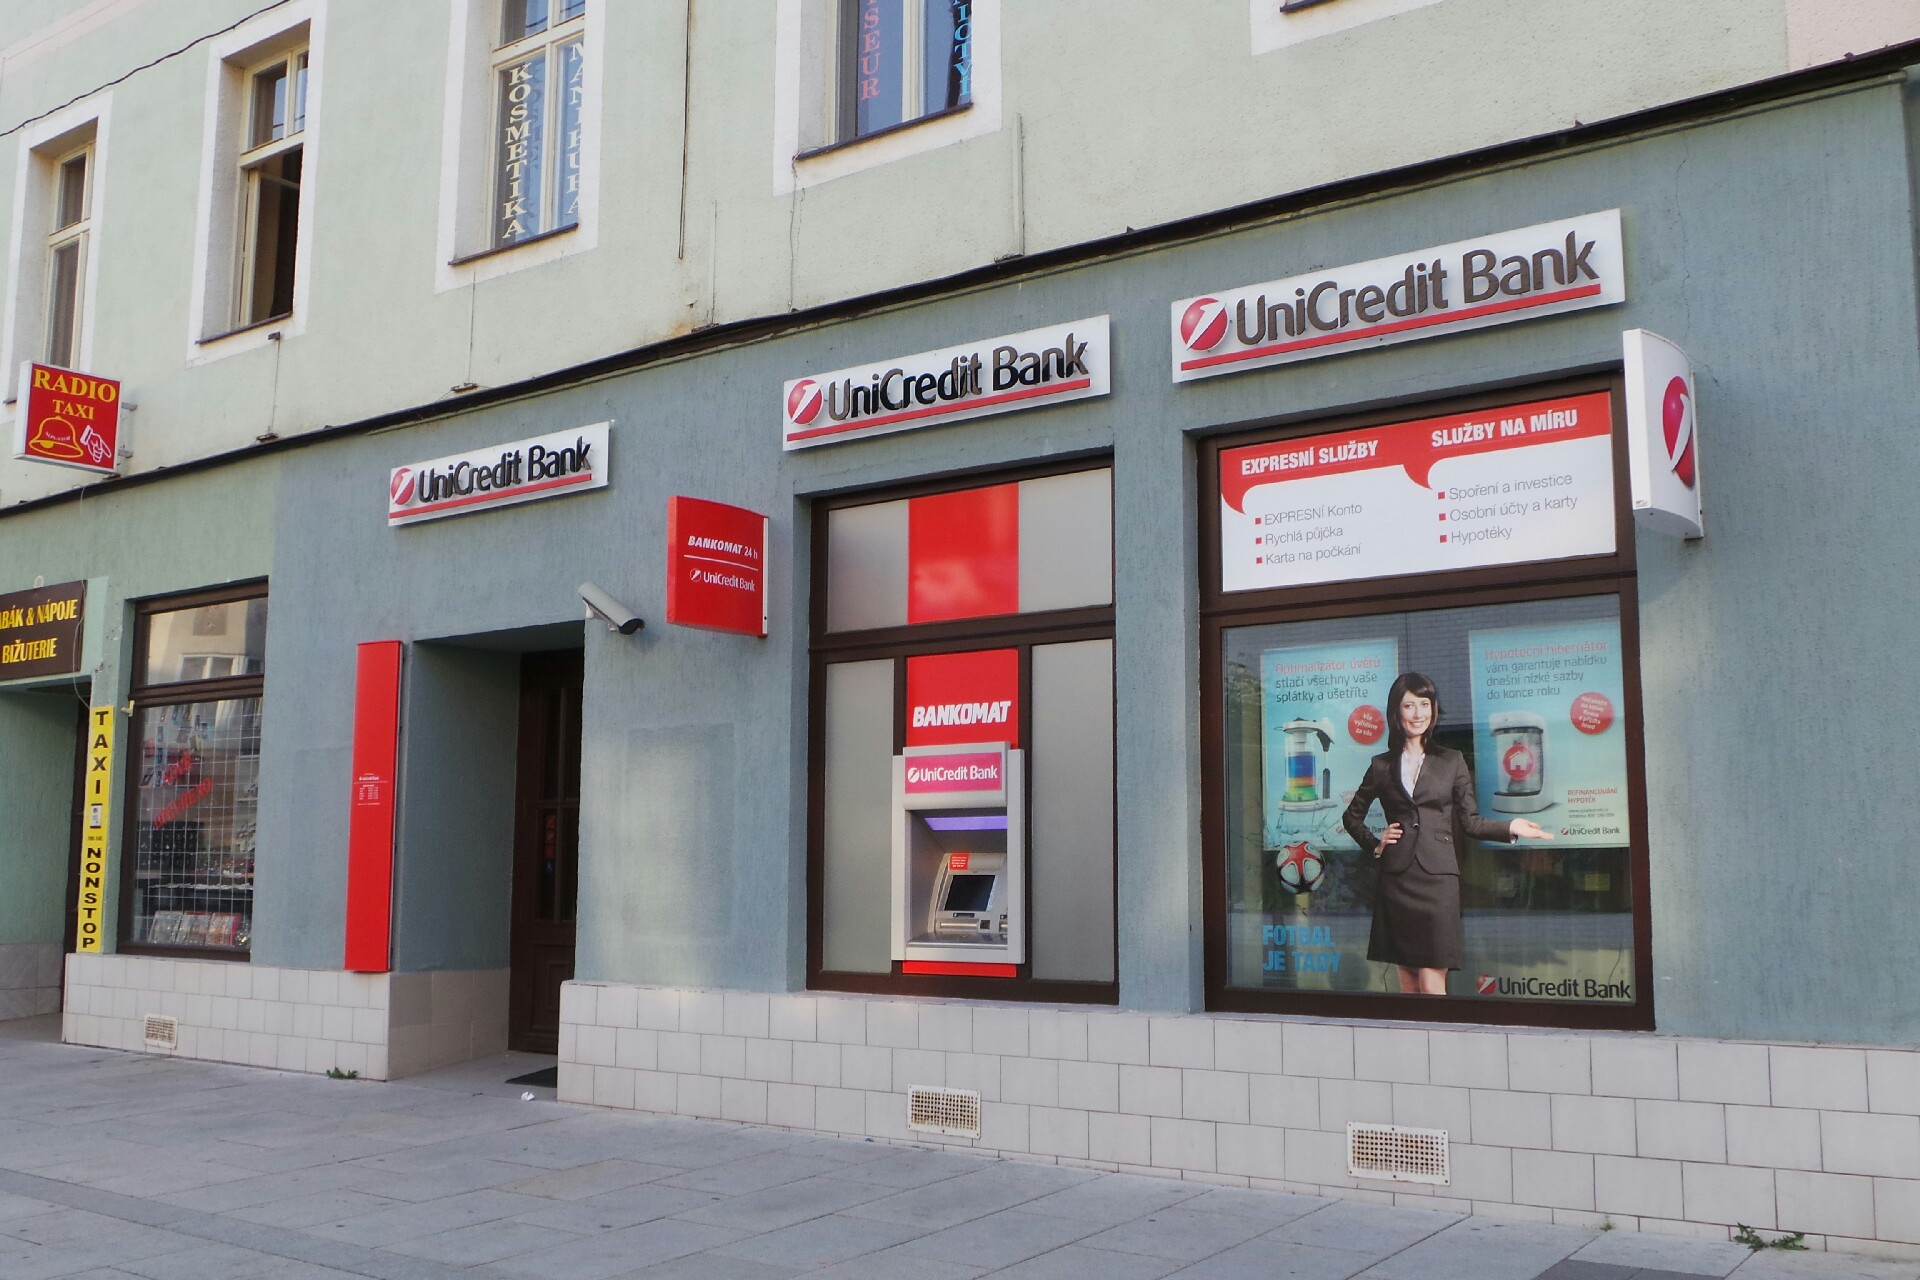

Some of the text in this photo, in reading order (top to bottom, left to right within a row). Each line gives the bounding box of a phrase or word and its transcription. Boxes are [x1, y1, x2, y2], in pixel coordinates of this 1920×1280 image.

[861, 0, 880, 100] SEUR
[503, 62, 533, 238] KOSMETIKA
[1236, 230, 1599, 345] UniCredit Bank
[33, 368, 116, 402] RADIO
[828, 332, 1089, 421] UniCredit Bank
[53, 399, 94, 420] TAXI
[1431, 409, 1578, 447] SLUŽBY NA MÍRU
[418, 435, 592, 503] UniCredit Bank
[1241, 439, 1378, 476] EXPRESNÍ SLUŽBY
[1449, 474, 1573, 501] Spoření a investice
[1264, 503, 1362, 526] EXPRESNÍ Konto
[1450, 495, 1578, 521] Osobní účty a karty
[688, 535, 758, 559] BANKOMAT 24 h
[1265, 526, 1344, 547] Rychlá půjčka
[1451, 526, 1513, 545] Hypotéky
[1265, 542, 1361, 565] Karta na počkání
[703, 571, 755, 592] UniCredit Bank
[0, 599, 78, 630] BÁK & NÁPOJE
[2, 638, 58, 664] BIŽUTERIE
[1485, 655, 1607, 674] vám garantuje nabídku
[1275, 671, 1378, 689] stlačí všechny vaše
[1486, 670, 1584, 687] dnešní nízké sazby
[1276, 686, 1369, 705] splátky a ušetříte
[1487, 685, 1560, 700] do konce roku
[912, 700, 1012, 728] BANKOMAT
[91, 710, 109, 795] TAXI
[920, 764, 998, 782] UniCredit Bank
[1569, 826, 1621, 836] UniCredit Bank
[82, 847, 102, 949] NONSTOP
[1262, 924, 1337, 949] FOTBAL
[1263, 950, 1343, 974] JE TADY
[1499, 976, 1632, 999] UniCredit Bank
